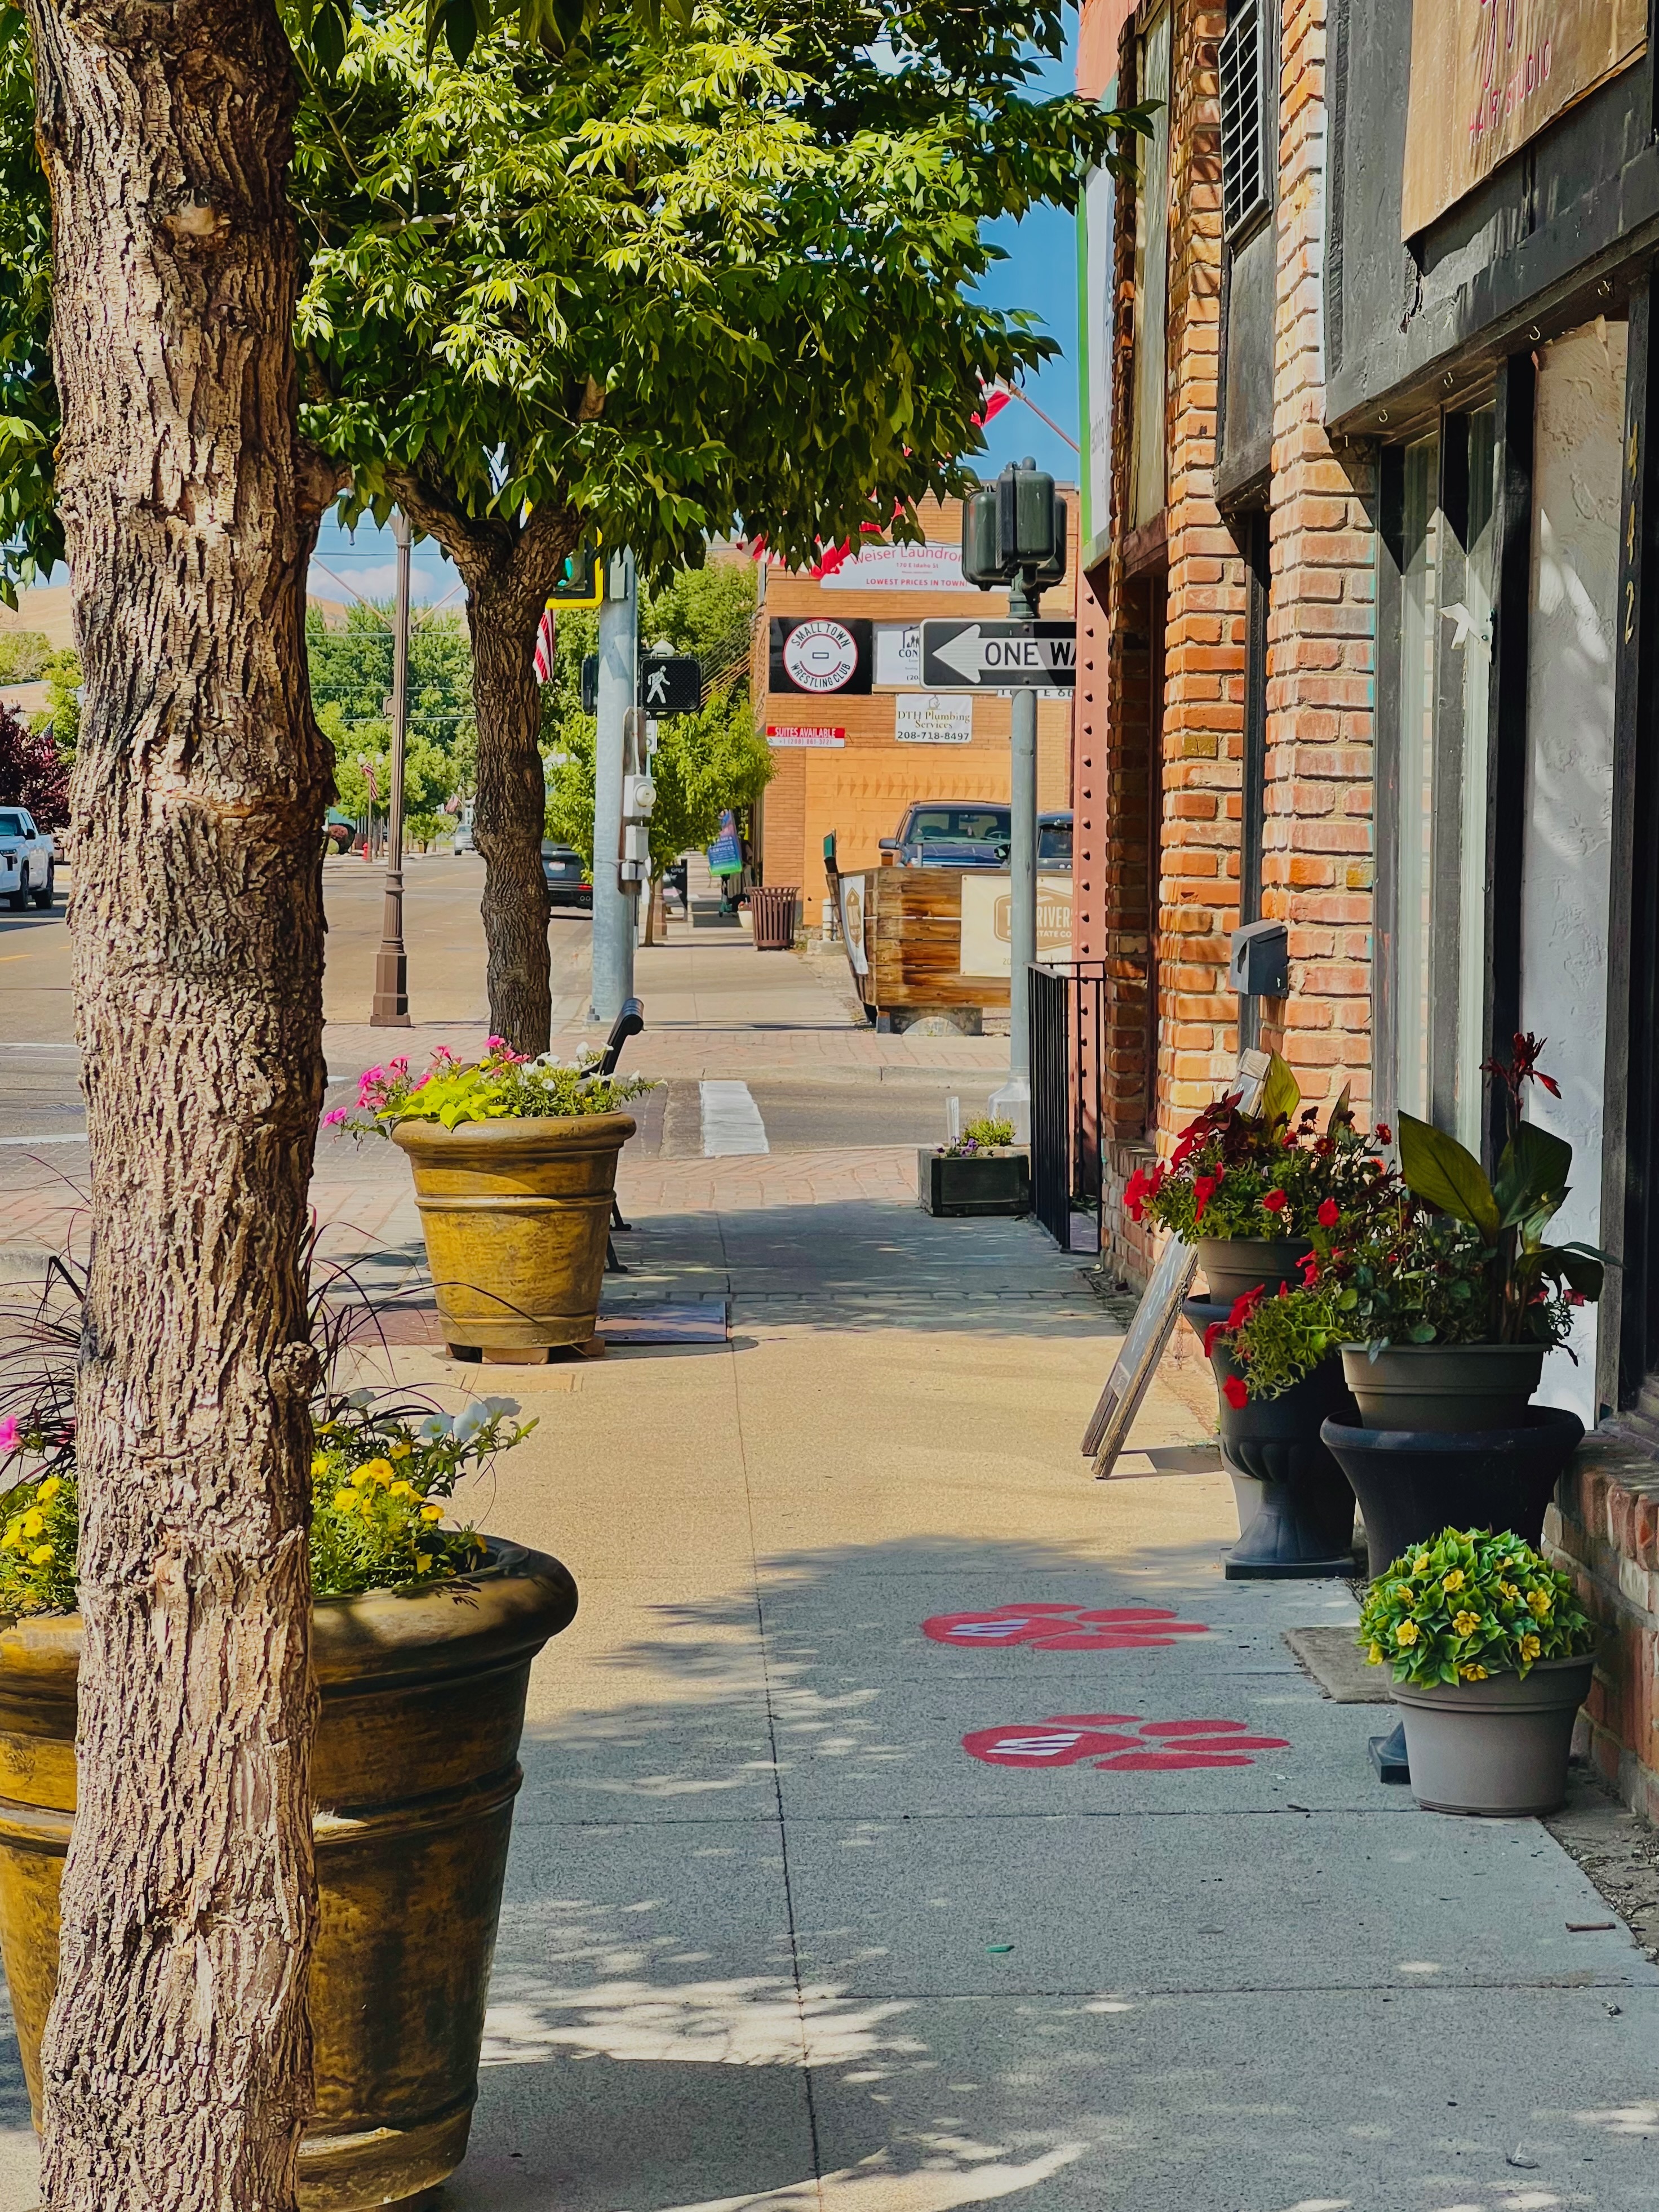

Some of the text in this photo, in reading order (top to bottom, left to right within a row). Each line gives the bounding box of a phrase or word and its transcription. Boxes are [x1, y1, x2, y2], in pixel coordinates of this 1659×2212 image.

[1469, 90, 1500, 150] HAIR
[1506, 39, 1552, 118] STUDIO
[850, 549, 896, 565] Weiser
[791, 623, 851, 647] SMALL TOWN
[899, 649, 919, 658] CON
[985, 641, 1039, 665] ONE
[791, 663, 851, 687] WRESTLING CLUB
[898, 710, 970, 723] DTH Plumbing
[915, 719, 952, 729] Services
[775, 727, 836, 738] SUITES AVAILABLE
[897, 731, 969, 740] 208-718-8497
[1036, 906, 1072, 928] RIVER
